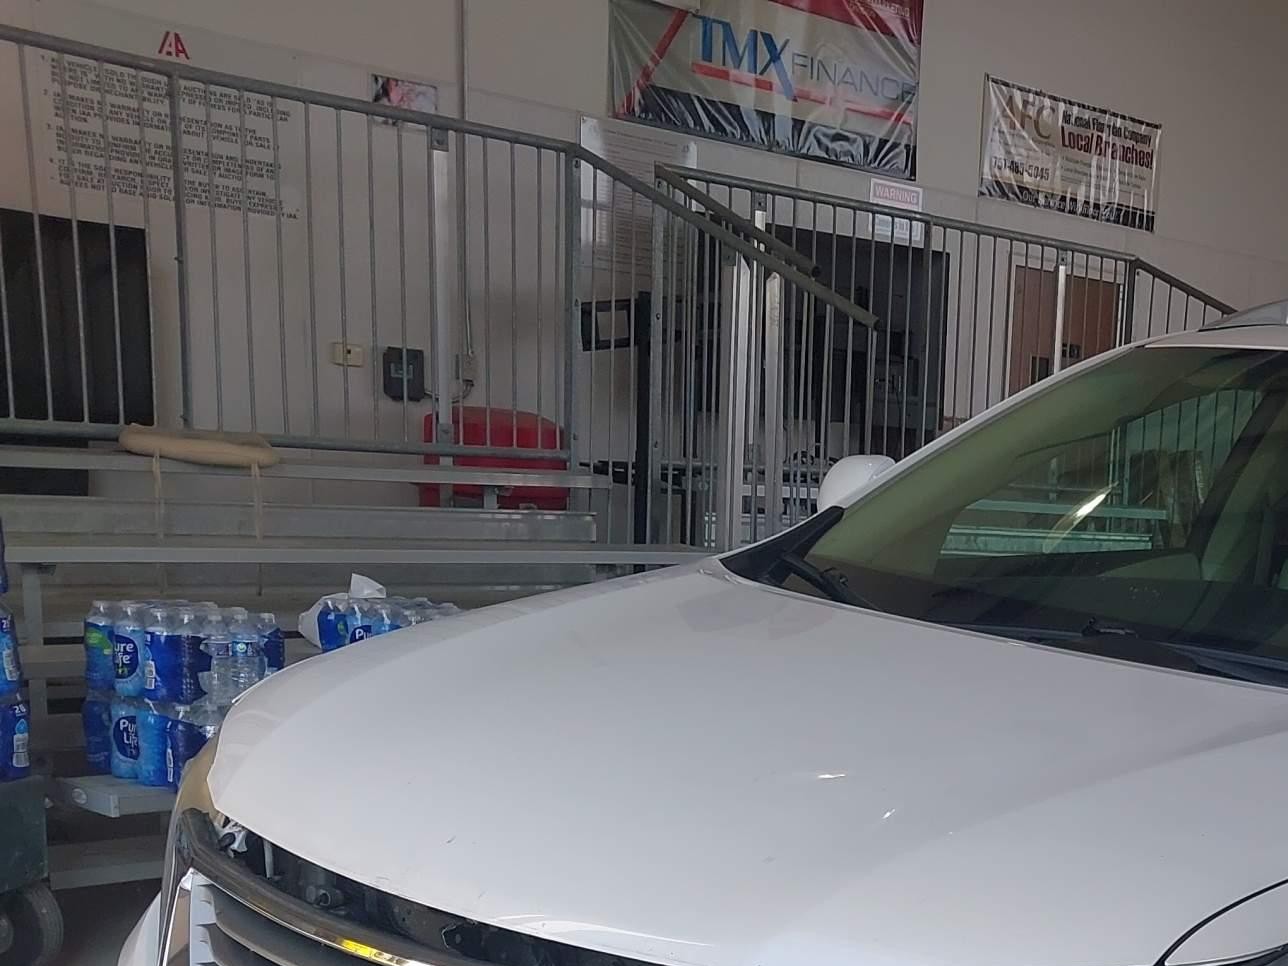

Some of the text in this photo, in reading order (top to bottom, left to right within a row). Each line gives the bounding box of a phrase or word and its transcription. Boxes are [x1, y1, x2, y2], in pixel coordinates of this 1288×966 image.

[1061, 126, 1094, 154] Local
[1094, 134, 1154, 169] Branches!
[874, 184, 919, 204] WARNING
[119, 719, 137, 733] Pur
